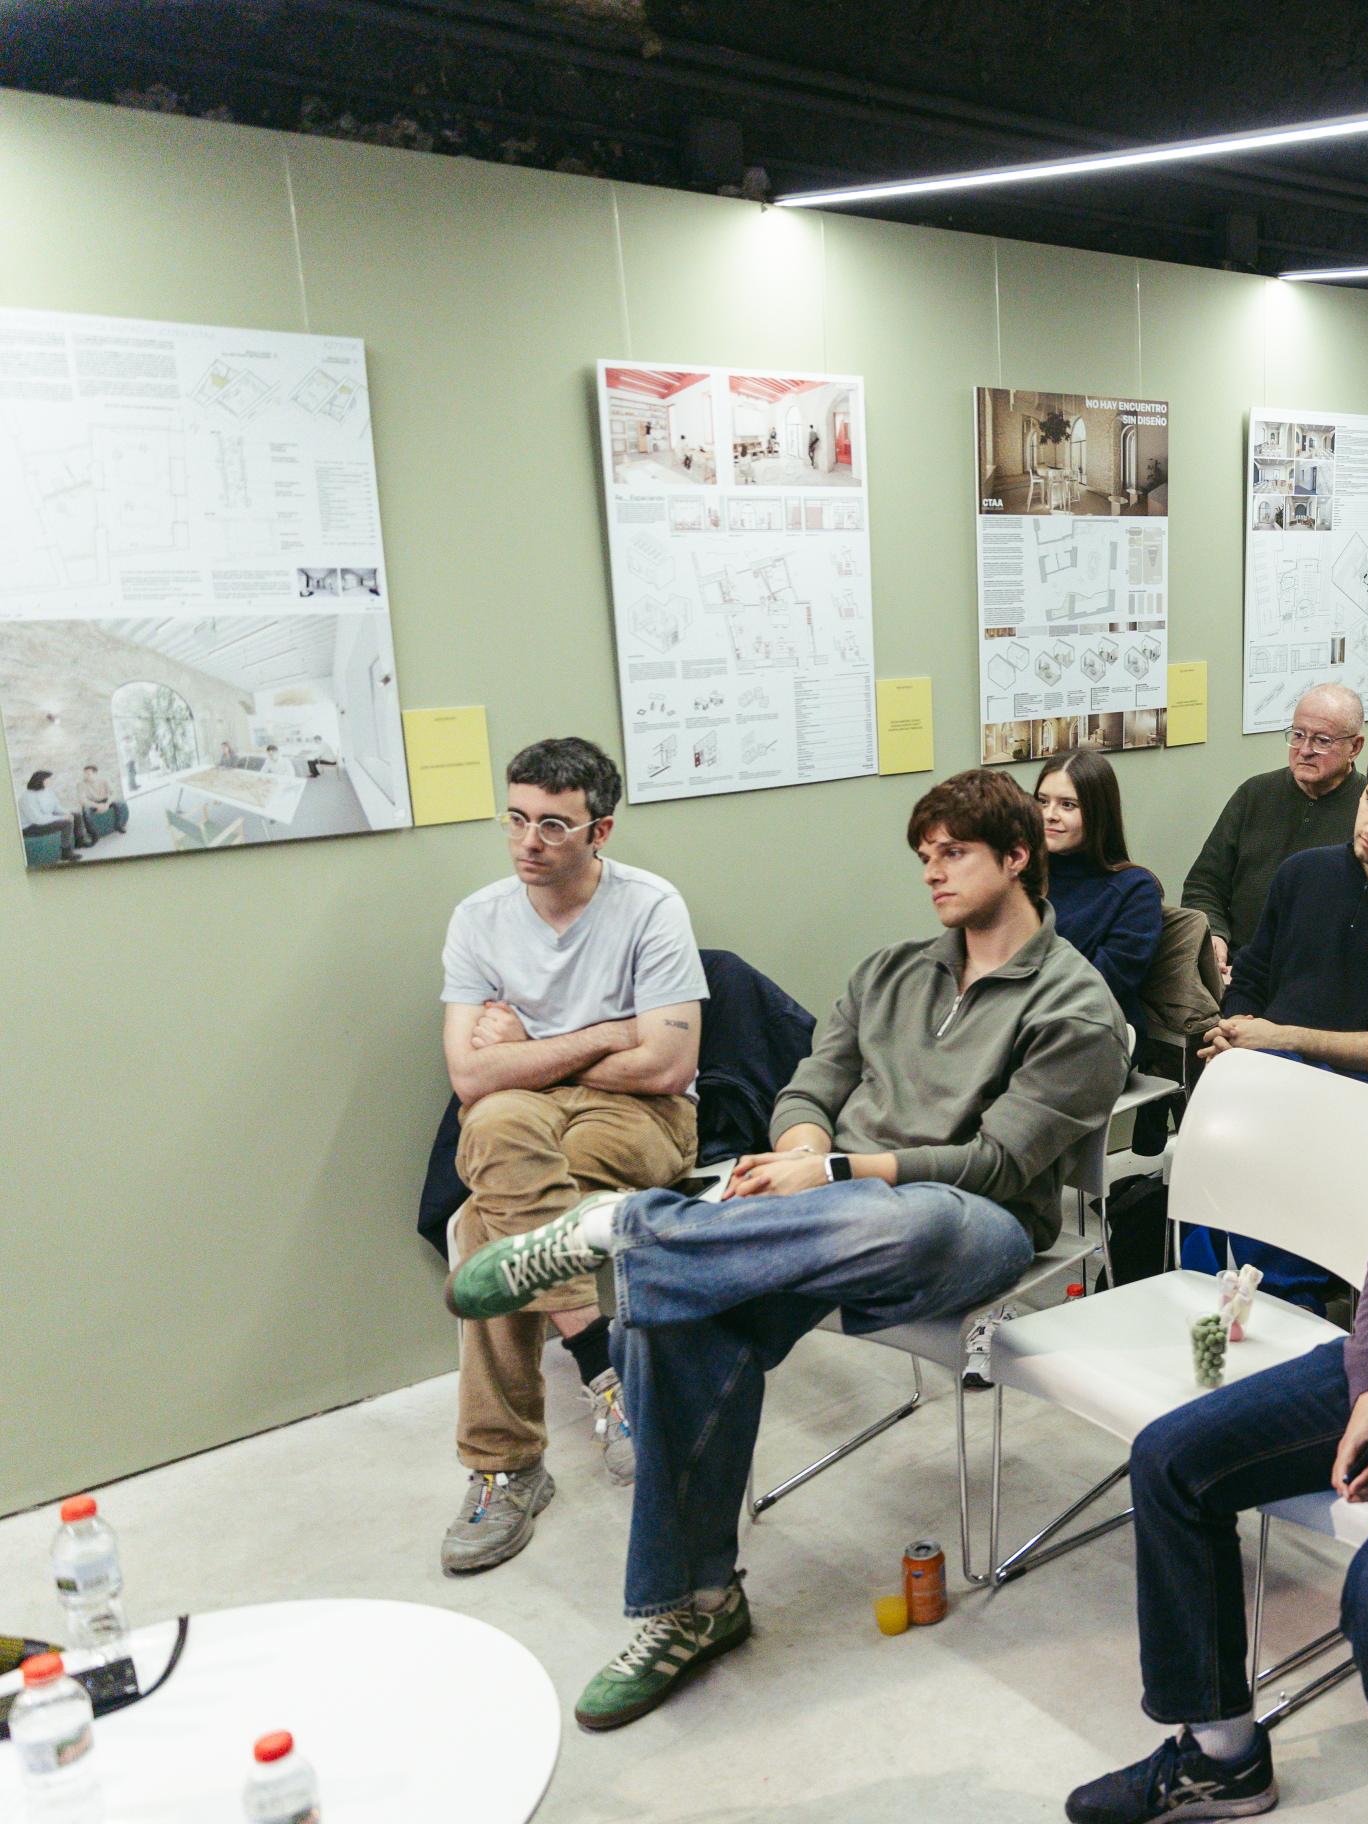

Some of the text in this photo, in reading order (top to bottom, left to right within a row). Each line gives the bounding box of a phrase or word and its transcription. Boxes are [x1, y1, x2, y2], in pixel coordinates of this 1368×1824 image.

[1086, 399, 1167, 413] NO HAY ENCUENTRO
[1122, 415, 1167, 426] SIN DISEÑO
[982, 498, 1004, 507] CTAA
